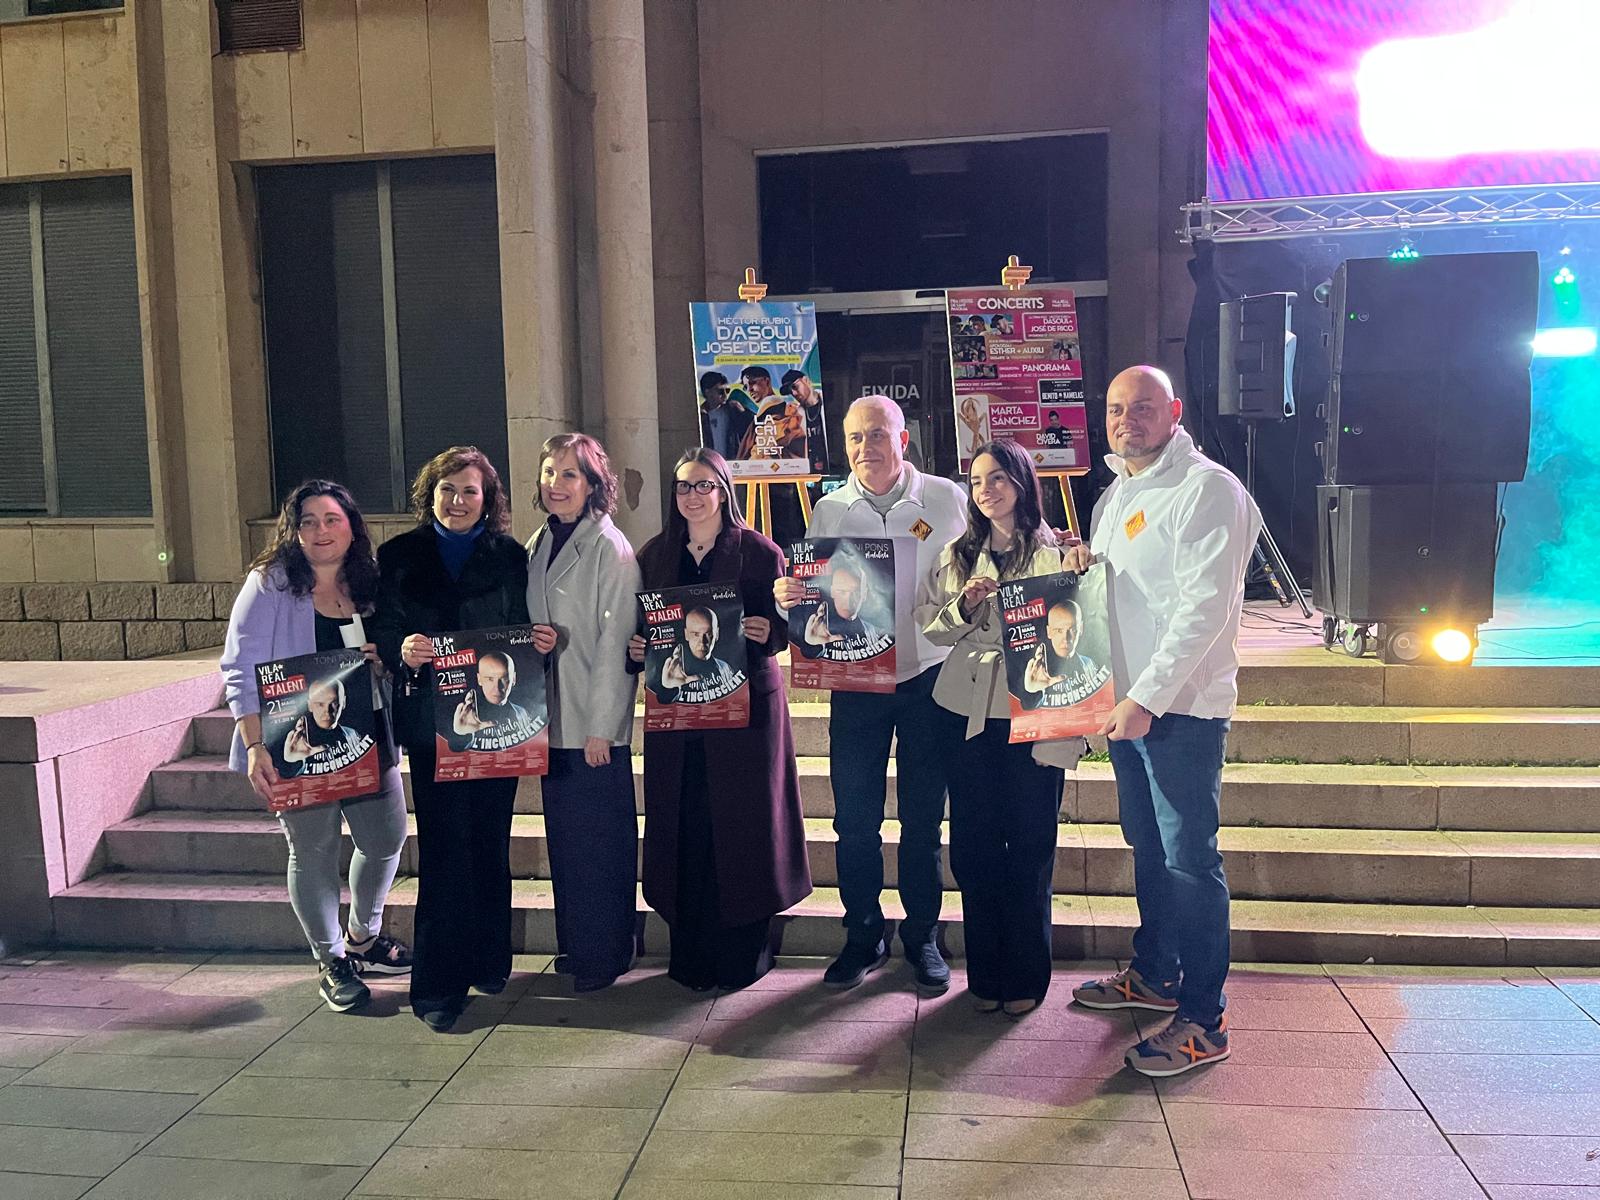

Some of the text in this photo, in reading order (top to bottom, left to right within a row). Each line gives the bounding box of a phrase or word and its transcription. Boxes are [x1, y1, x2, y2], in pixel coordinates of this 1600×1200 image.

[977, 297, 1045, 310] CONCERTS
[718, 314, 791, 325] HÉCTOR RUBIO
[716, 325, 803, 341] DASOUL
[748, 341, 771, 353] DE
[776, 341, 813, 353] RICO
[990, 347, 1016, 355] ESTHER
[1022, 364, 1071, 372] PANORAMA
[991, 406, 1024, 415] MARTA
[754, 414, 774, 425] LA
[991, 415, 1037, 426] SÁNCHEZ
[754, 425, 777, 436] CRI
[756, 436, 778, 447] DA
[756, 446, 784, 456] FEST
[791, 542, 810, 554] VILA
[865, 543, 889, 552] PONS
[793, 553, 815, 564] REAL
[1053, 577, 1076, 587] TONI
[638, 592, 658, 603] VILA
[999, 585, 1019, 598] VILA
[643, 600, 666, 612] REAL
[1002, 594, 1027, 609] REAL
[652, 608, 682, 622] TALENT
[1010, 603, 1044, 621] TALENT
[486, 629, 532, 640] TONI PON
[649, 626, 662, 641] 21
[1008, 625, 1023, 642] 21
[429, 636, 449, 647] VILA
[823, 634, 893, 661] L'INCONSCIENT
[337, 651, 360, 661] PON
[433, 644, 457, 657] REAL
[441, 653, 474, 668] TALENT
[257, 663, 279, 676] VILA
[261, 671, 287, 685] REAL
[437, 671, 452, 686] 21
[271, 678, 305, 697] TALENT
[678, 669, 746, 703] L'INCONSCIENT
[1043, 664, 1111, 706] L'INCONSCIENT
[266, 700, 282, 715] 21
[472, 715, 545, 750] L'INCONSCIENT
[303, 734, 375, 774] L'INCONSCIENT
